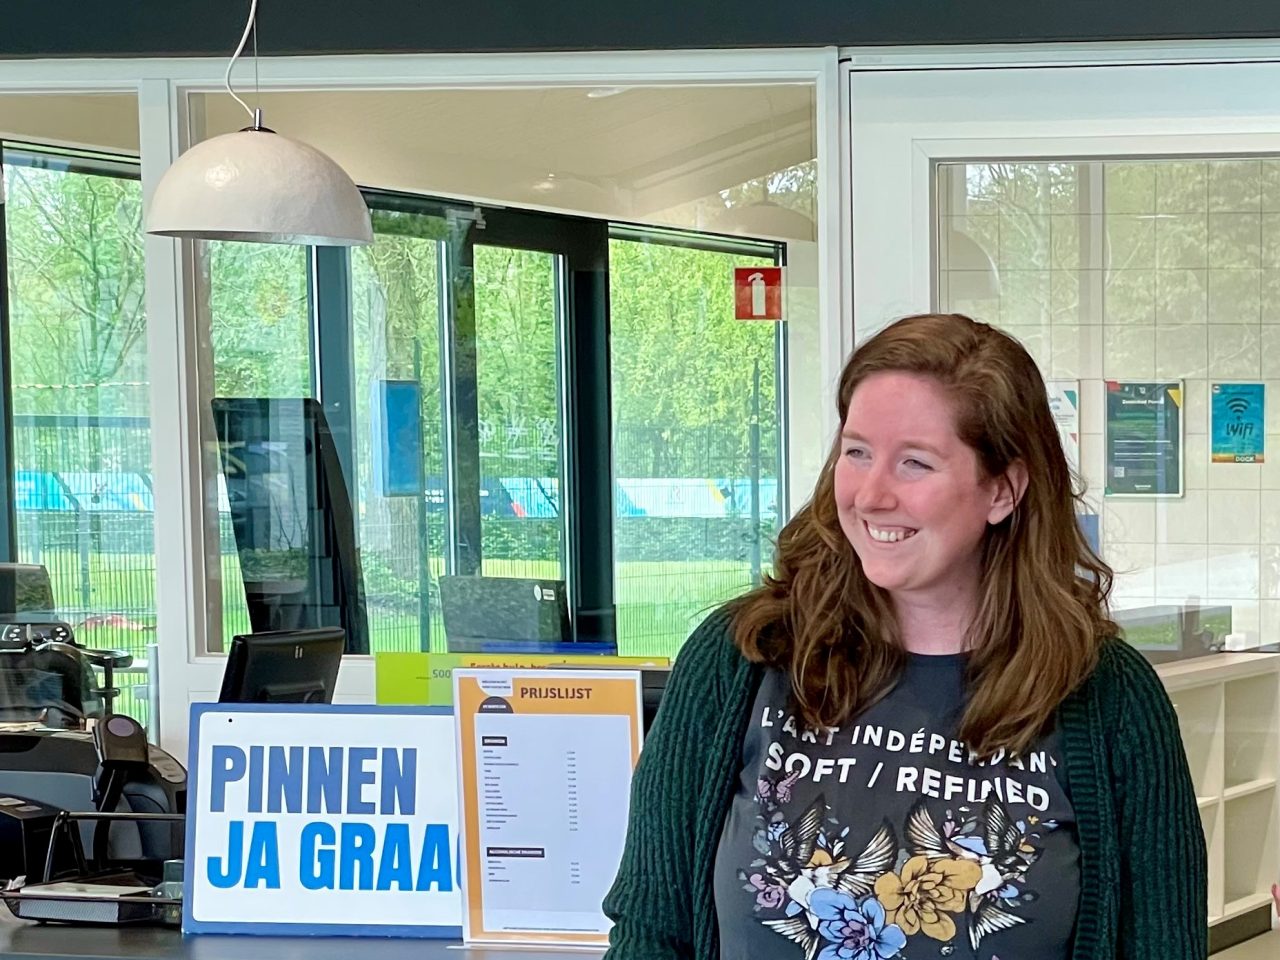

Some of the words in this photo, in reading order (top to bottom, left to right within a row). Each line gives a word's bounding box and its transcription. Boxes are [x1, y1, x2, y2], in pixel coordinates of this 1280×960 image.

[520, 687, 593, 700] PRIJSLIJST
[208, 744, 418, 815] PINNEN
[765, 741, 857, 784] SOFT
[896, 766, 1050, 812] REFINED
[206, 820, 281, 889] JA
[299, 820, 461, 893] GRAA
